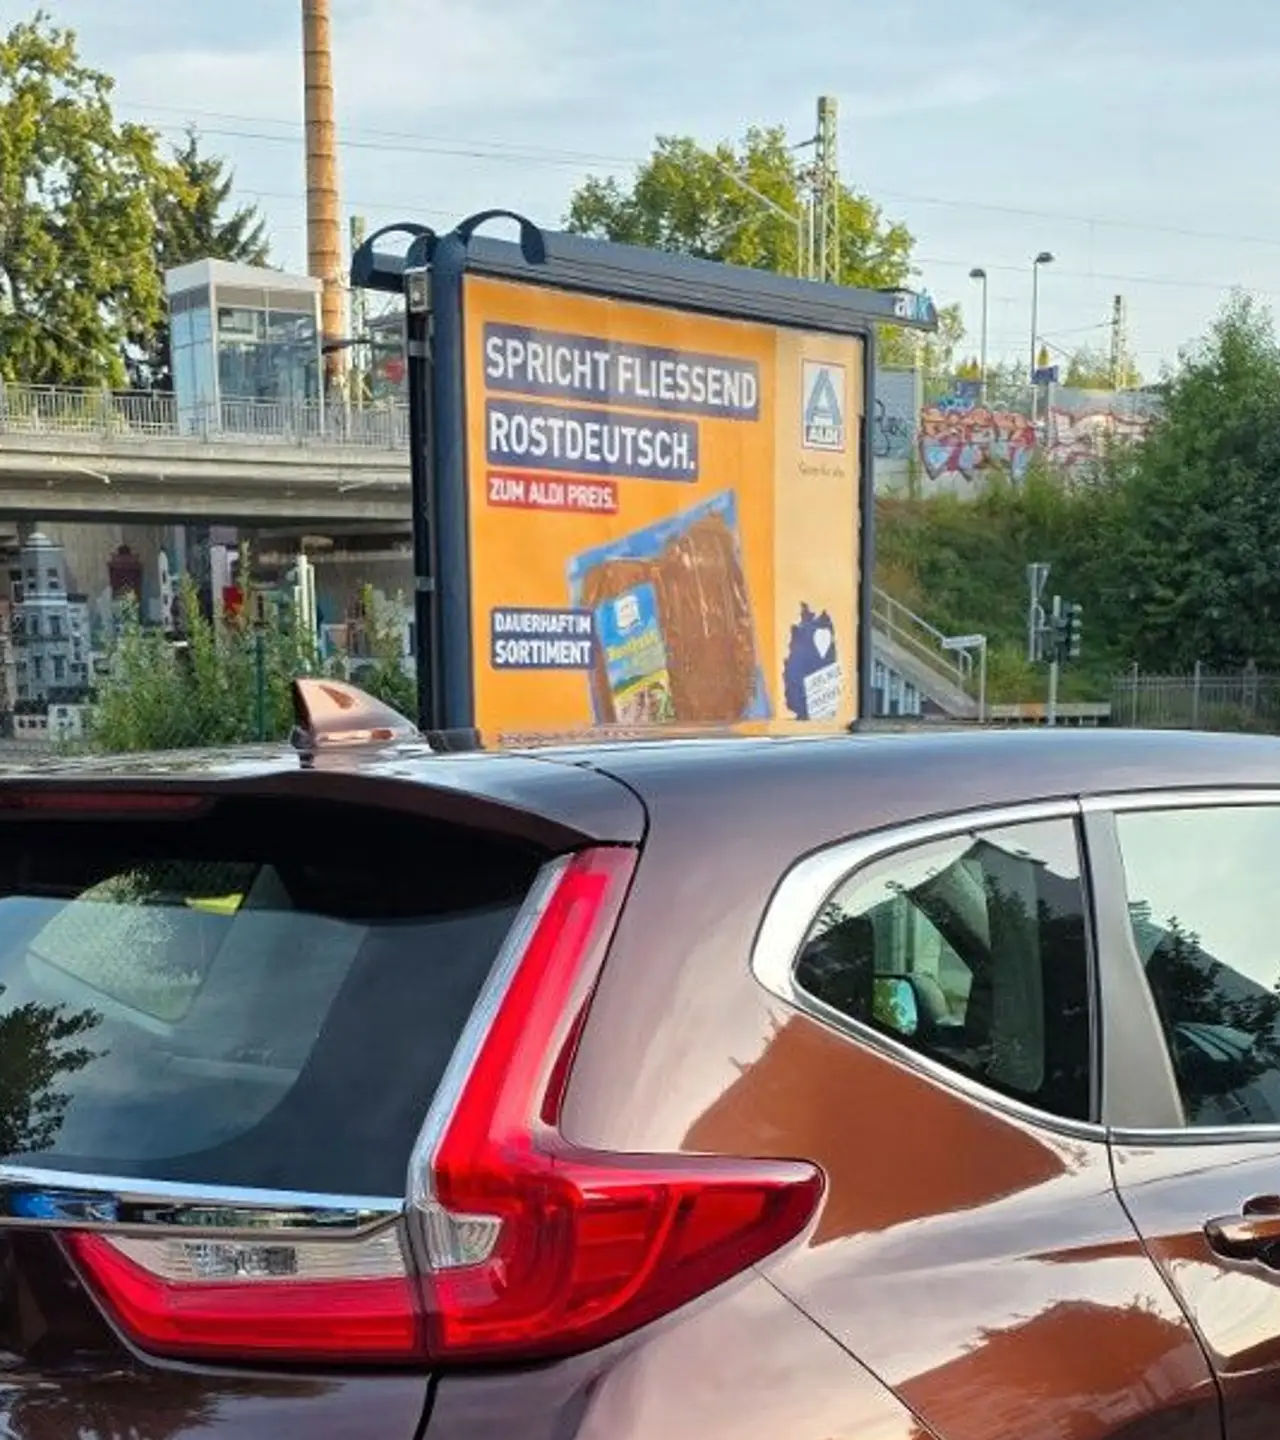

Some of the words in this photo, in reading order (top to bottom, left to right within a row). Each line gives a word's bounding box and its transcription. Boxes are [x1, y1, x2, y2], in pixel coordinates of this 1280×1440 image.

[485, 336, 610, 392] SPRICHT
[617, 354, 758, 409] FLIESSEND
[489, 411, 697, 470] ROSTDEUTSCH.
[489, 477, 524, 502] ZUM
[528, 483, 564, 505] ALDI
[493, 611, 574, 633] DAUERHAFT
[575, 613, 591, 635] IM
[494, 638, 592, 665] SORTIMENT
